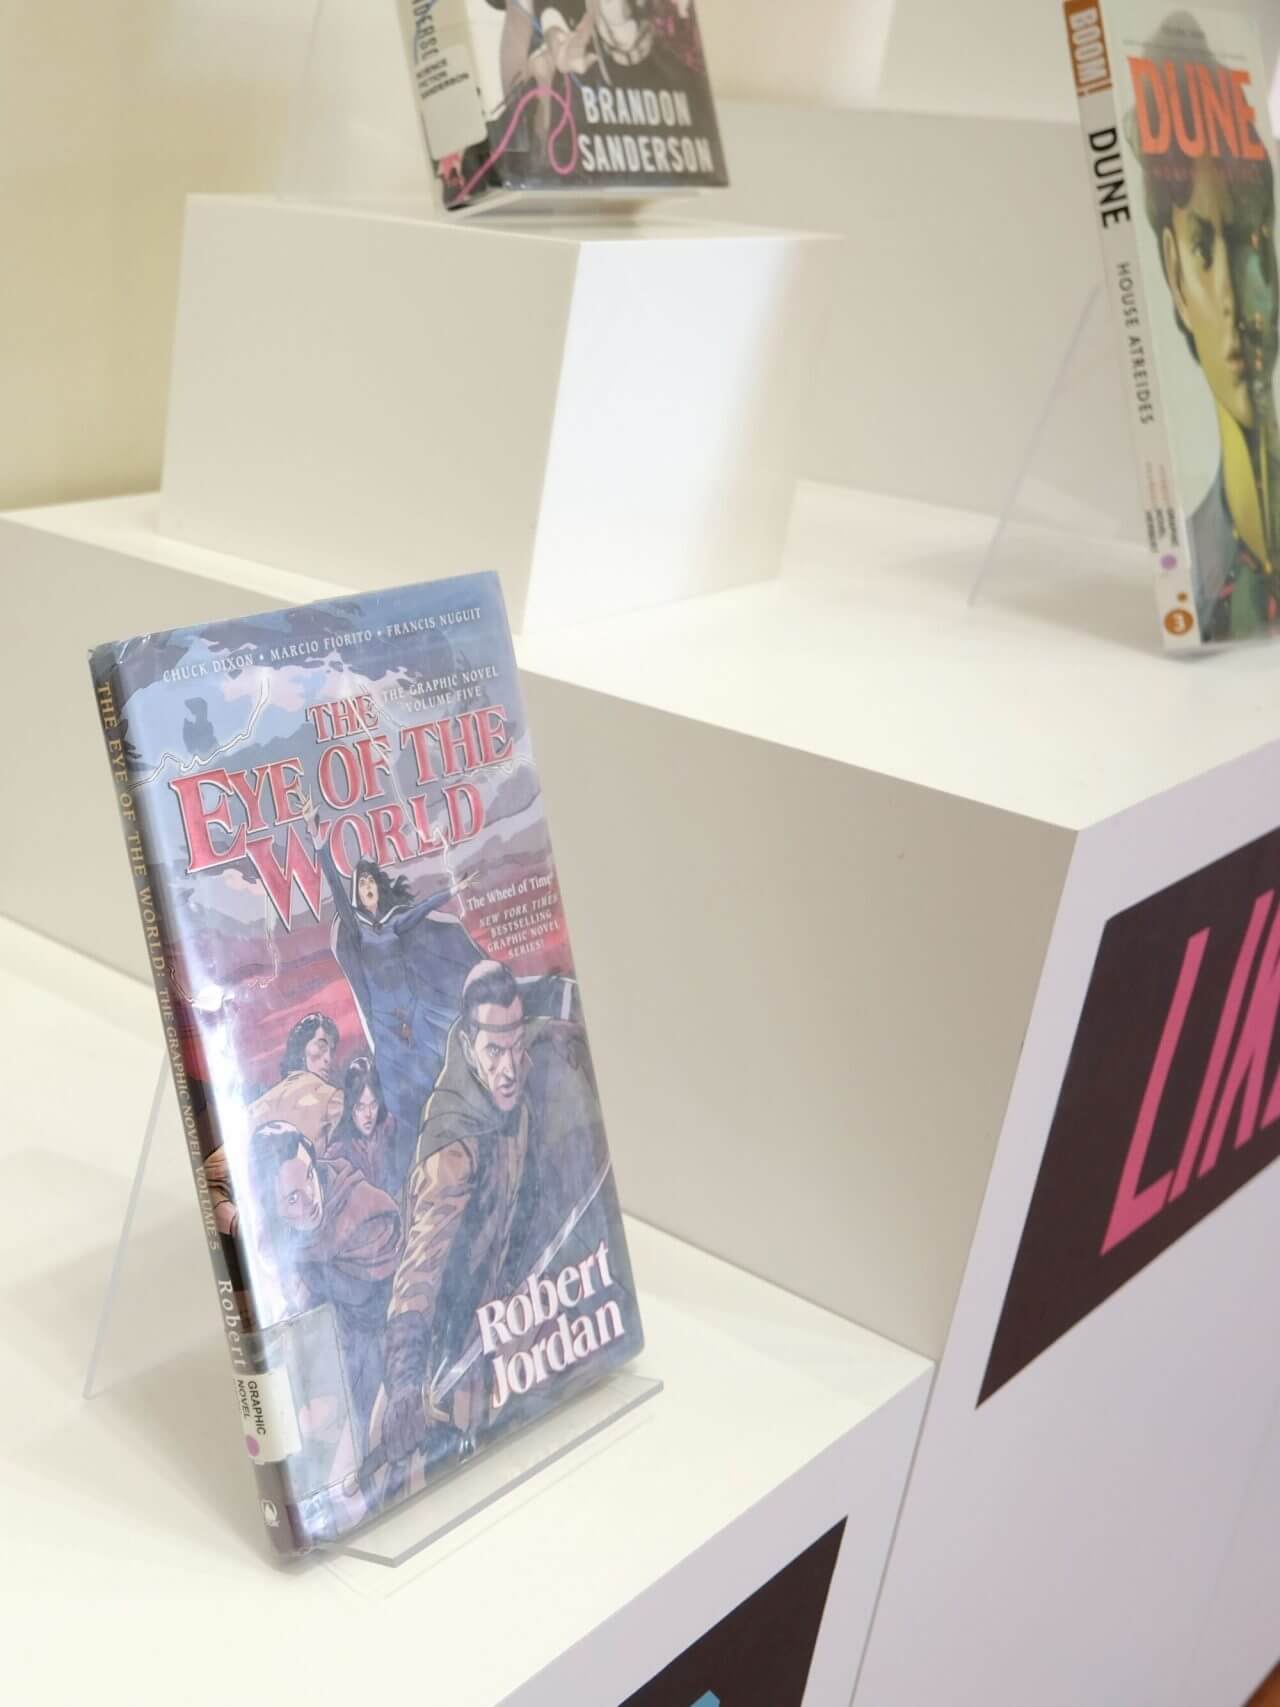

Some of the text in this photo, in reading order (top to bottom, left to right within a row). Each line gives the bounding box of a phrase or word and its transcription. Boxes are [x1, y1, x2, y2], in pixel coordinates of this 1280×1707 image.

[579, 86, 692, 127] BRANDON
[1126, 54, 1267, 161] DUNE
[577, 133, 715, 174] SANDERSON
[1088, 127, 1132, 229] DUNE
[1116, 262, 1155, 426] HOUSE ATREIDES
[162, 607, 482, 683] CHUCK DIXON MARCIO FIORITO FRANCIS NUGUIT
[97, 681, 119, 732] THE
[382, 665, 499, 702] THE GRAPHIC NOVEL
[404, 684, 483, 713] VOLUME FIVE
[306, 692, 379, 744] THE
[108, 736, 129, 788] EYE
[120, 790, 137, 823] OF
[168, 703, 514, 875] EYE OF THE
[126, 830, 148, 876] THE
[244, 780, 486, 933] WORLD
[466, 895, 486, 911] The
[485, 884, 517, 904] Wheel
[517, 877, 529, 894] of
[503, 903, 529, 921] YORK
[138, 885, 167, 979] WORLD:
[486, 919, 561, 953] GRAPHIC NOVEL
[489, 910, 553, 939] BESTSELLING
[158, 988, 175, 1025] THE
[167, 1026, 190, 1102] GRAPHIC
[1099, 887, 1280, 1257] LIK
[182, 1104, 202, 1163] NOVEL
[195, 1165, 218, 1238] VOLUME
[217, 1279, 247, 1367] Robert
[476, 1240, 615, 1356] Robert
[489, 1299, 626, 1410] Jordan
[237, 1378, 250, 1419] NOVEL
[247, 1380, 267, 1435] GRAPHIC
